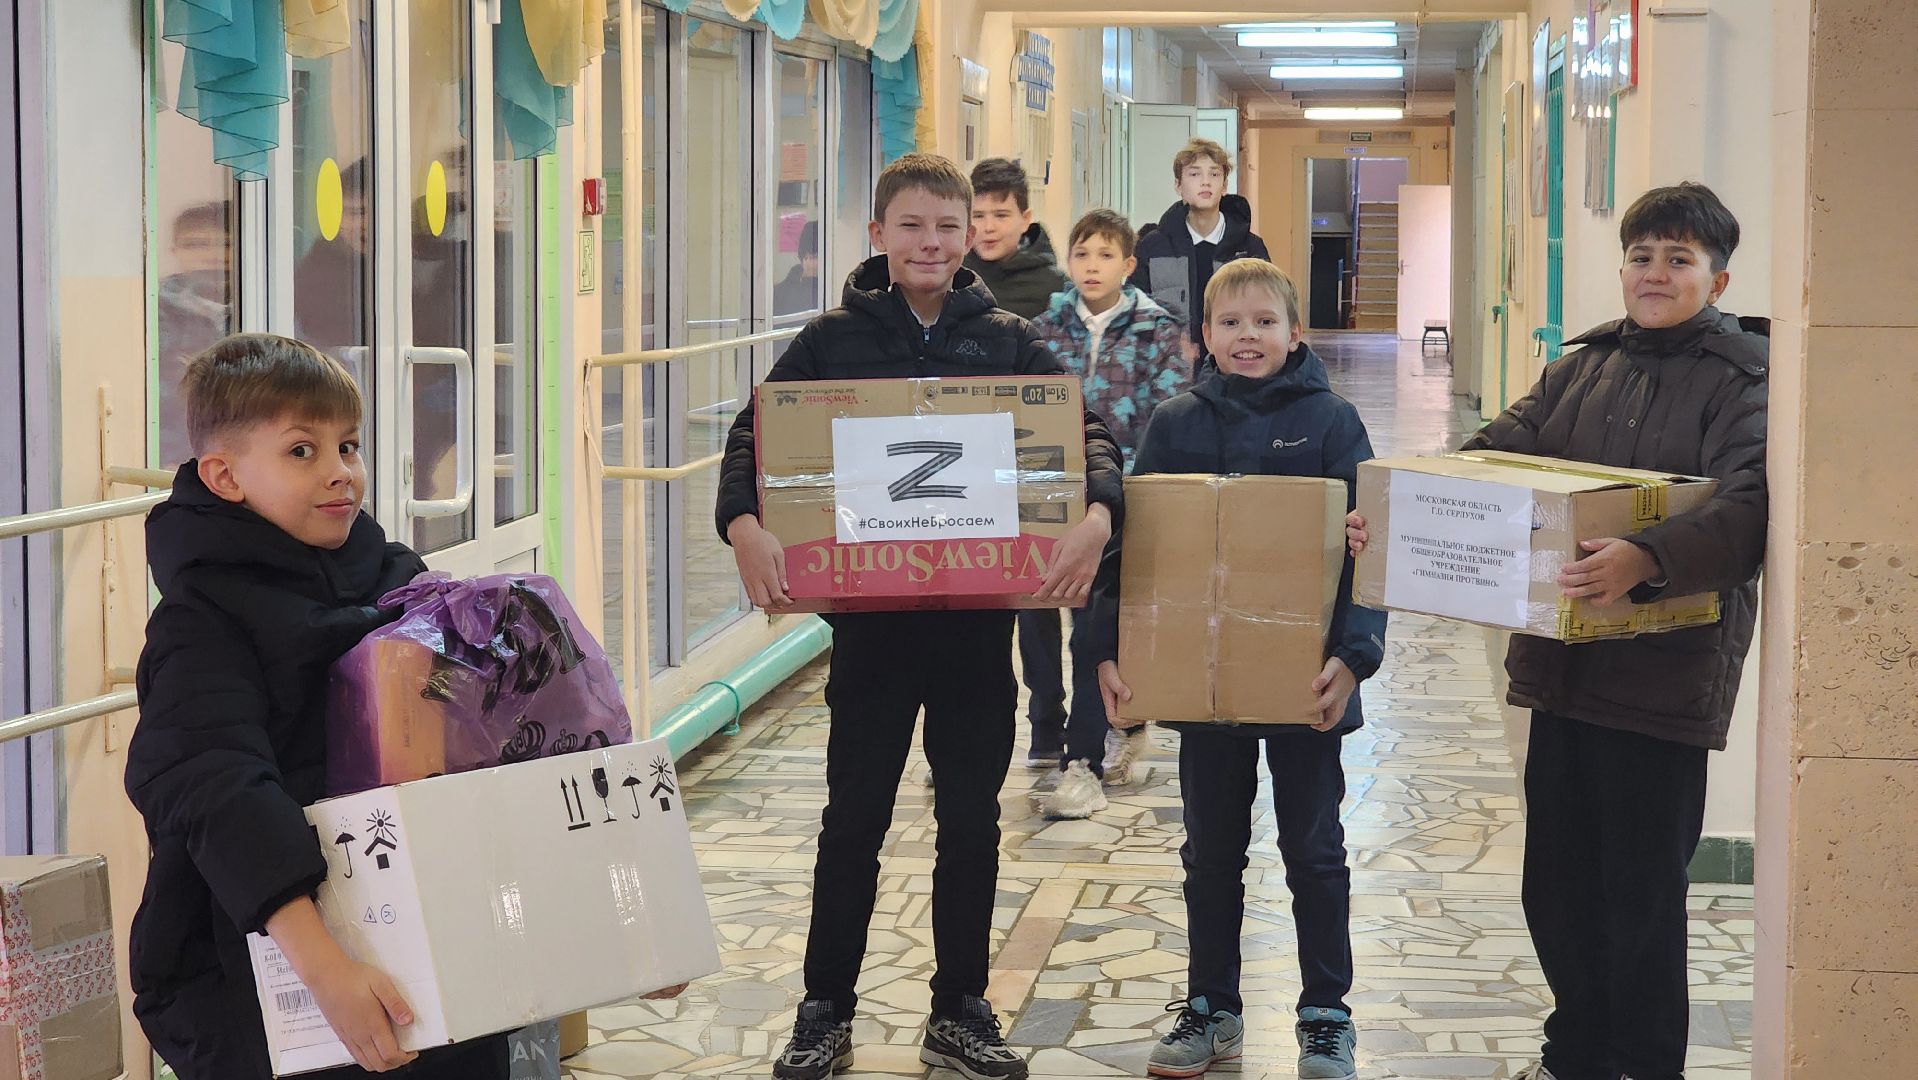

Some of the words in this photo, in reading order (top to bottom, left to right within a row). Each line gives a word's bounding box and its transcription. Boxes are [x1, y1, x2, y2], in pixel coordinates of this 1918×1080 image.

[886, 441, 968, 502] Z
[1415, 494, 1466, 508] МОСКОВСКАЯ
[1468, 501, 1502, 513] ОБЛАСТЬ
[859, 516, 995, 529] #СвоихНеБросаем
[1446, 509, 1485, 521] СЕРПУХОВ
[1411, 546, 1503, 567] ОБЩЕОБРАЗОВАТЕЛЬНОЕ
[1466, 544, 1517, 558] БЮДЖЕТНОЕ
[806, 541, 1051, 584] ViewSonic
[1431, 560, 1481, 575] УЧРЕЖДЕНИЕ
